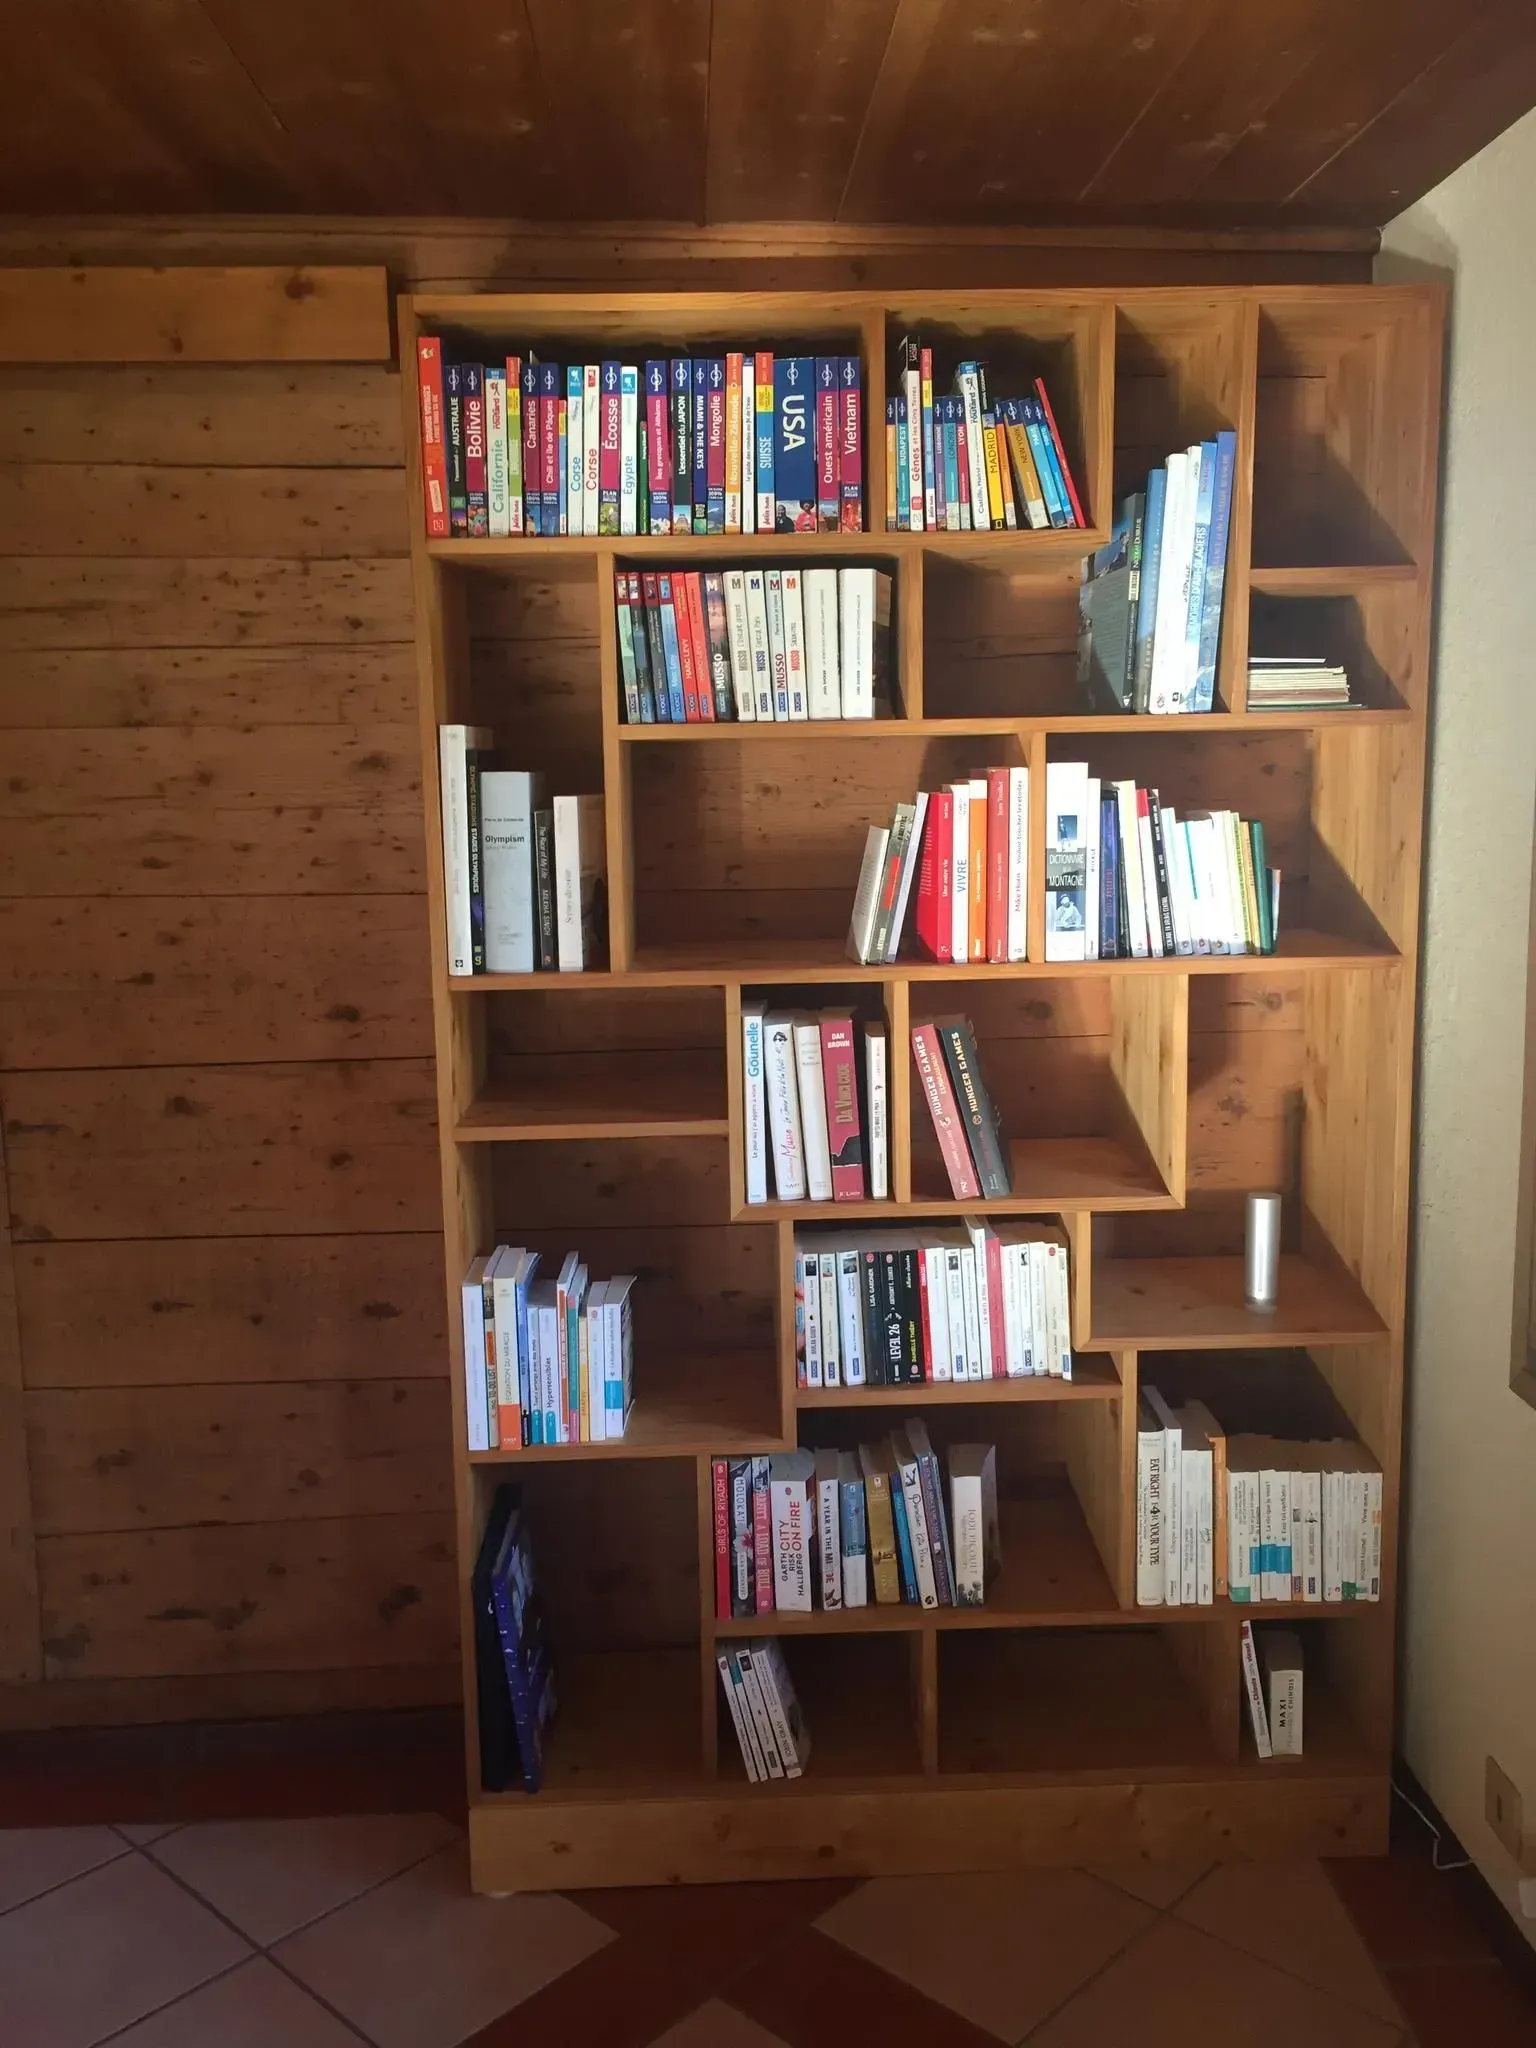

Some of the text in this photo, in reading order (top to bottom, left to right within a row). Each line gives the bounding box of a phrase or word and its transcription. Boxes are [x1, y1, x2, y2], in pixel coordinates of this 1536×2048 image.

[450, 397, 460, 445] AUSTRALIE
[527, 400, 536, 449] Canaries
[545, 400, 555, 430] Pâques
[602, 399, 618, 450] Écosse
[696, 396, 704, 422] MIAMI
[710, 396, 722, 447] Mongolie
[782, 394, 806, 452] USA
[844, 394, 858, 455] Vietnam
[467, 401, 482, 458] Bolivie
[546, 431, 553, 442] de
[677, 396, 687, 475] L'essentiel du JAPON
[823, 396, 834, 484] Ouest américain
[899, 425, 907, 466] BUDAPEST
[958, 426, 966, 446] LYON
[1014, 427, 1029, 464] NEW YORK
[586, 448, 597, 490] Corse
[759, 437, 772, 469] SUISSE
[911, 448, 921, 482] Gênes
[986, 431, 998, 474] MADRID
[492, 439, 504, 513] Californie
[546, 466, 554, 484] Chili
[571, 457, 581, 492] Corse
[623, 456, 636, 495] Égypte
[682, 638, 690, 661] LEVY
[756, 650, 766, 672] MUSSO
[790, 650, 800, 671] MUSSO
[713, 653, 725, 689] MUSSO
[775, 653, 786, 689] MUSSO
[471, 828, 479, 852] STADES
[485, 835, 525, 844] Olympism
[472, 854, 480, 893] OLYMPIQUES
[956, 859, 967, 892] VIVRE
[1049, 875, 1084, 886] MONTAGNE
[1014, 893, 1022, 912] Mike
[748, 1022, 760, 1078] Gounelle
[827, 1041, 850, 1049] BROWN
[914, 1035, 943, 1116] HUNGER GAMES
[951, 1032, 979, 1112] HUNGER GAMES
[781, 1129, 798, 1159] Musso
[888, 1323, 900, 1335] 26
[545, 1356, 556, 1408] Hypersensibles
[717, 1479, 726, 1553] GIRLS OF RIYADH
[780, 1501, 802, 1551] CITY ON FIRE
[823, 1505, 831, 1524] YEAR
[1150, 1458, 1161, 1566] EAT RIGHT YOUR TYPE
[756, 1532, 769, 1555] LOAD
[824, 1526, 832, 1534] IN
[824, 1536, 832, 1552] THE
[780, 1553, 788, 1581] GARTH
[968, 1534, 978, 1575] PICOULT
[757, 1568, 771, 1591] BULL
[794, 1553, 804, 1596] HALLBERG
[1287, 1678, 1295, 1710] CHINOIS
[1279, 1699, 1287, 1728] MAXI
